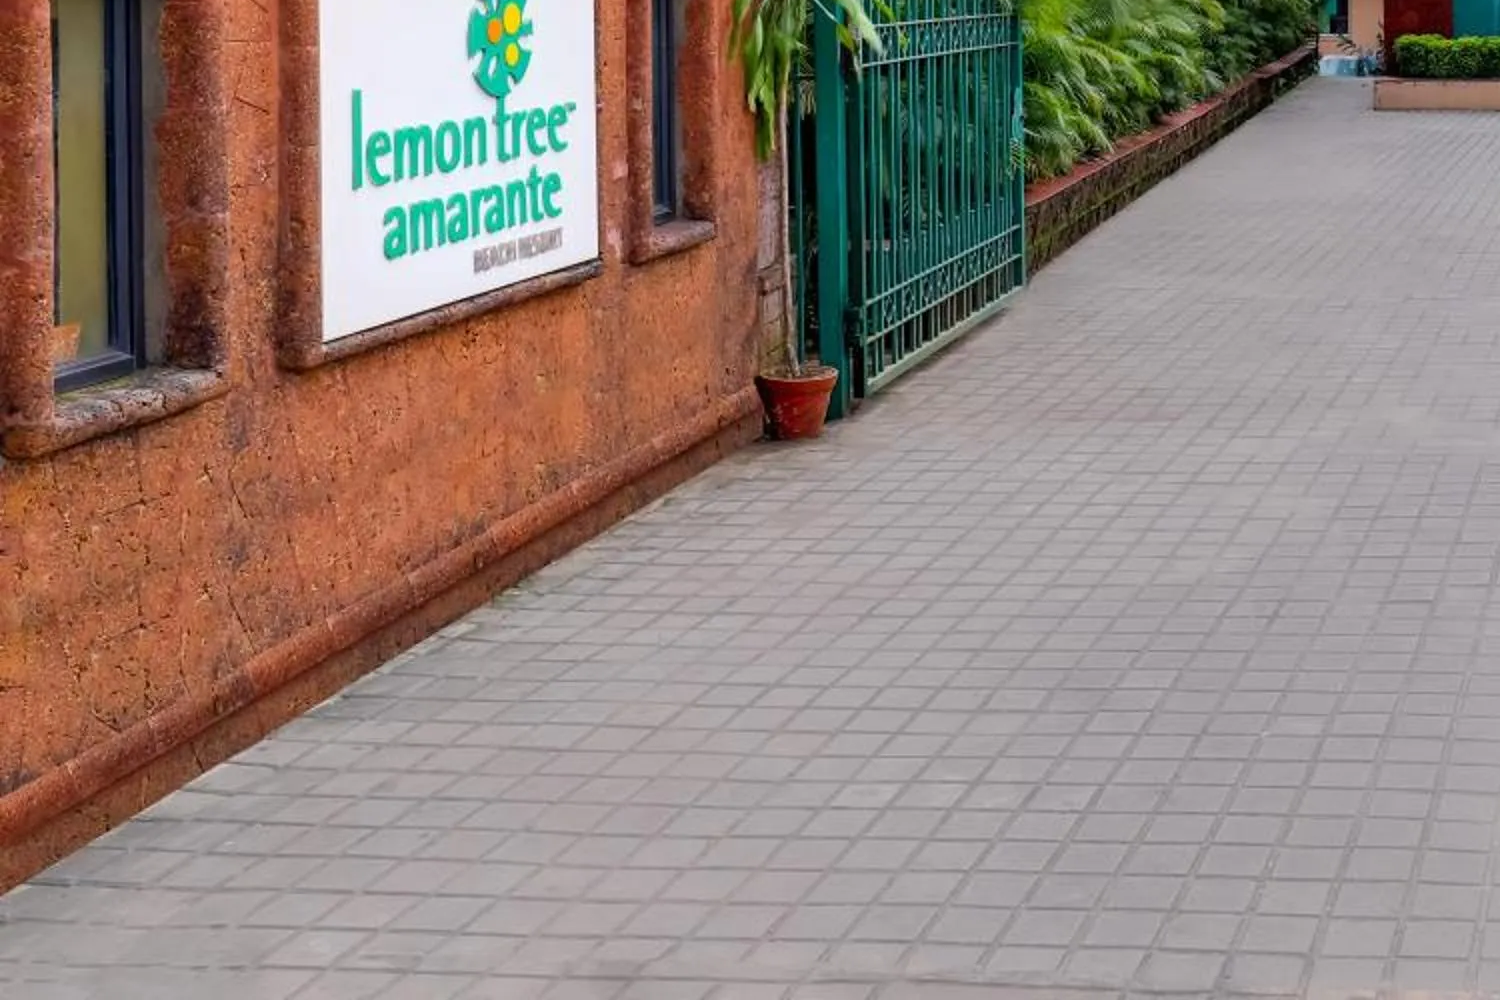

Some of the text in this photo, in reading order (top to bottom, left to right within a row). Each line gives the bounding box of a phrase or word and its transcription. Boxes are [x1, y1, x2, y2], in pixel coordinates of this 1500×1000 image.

[351, 88, 569, 191] lemon tree
[382, 164, 564, 261] amarante
[473, 227, 563, 274] BEACH RESORT
